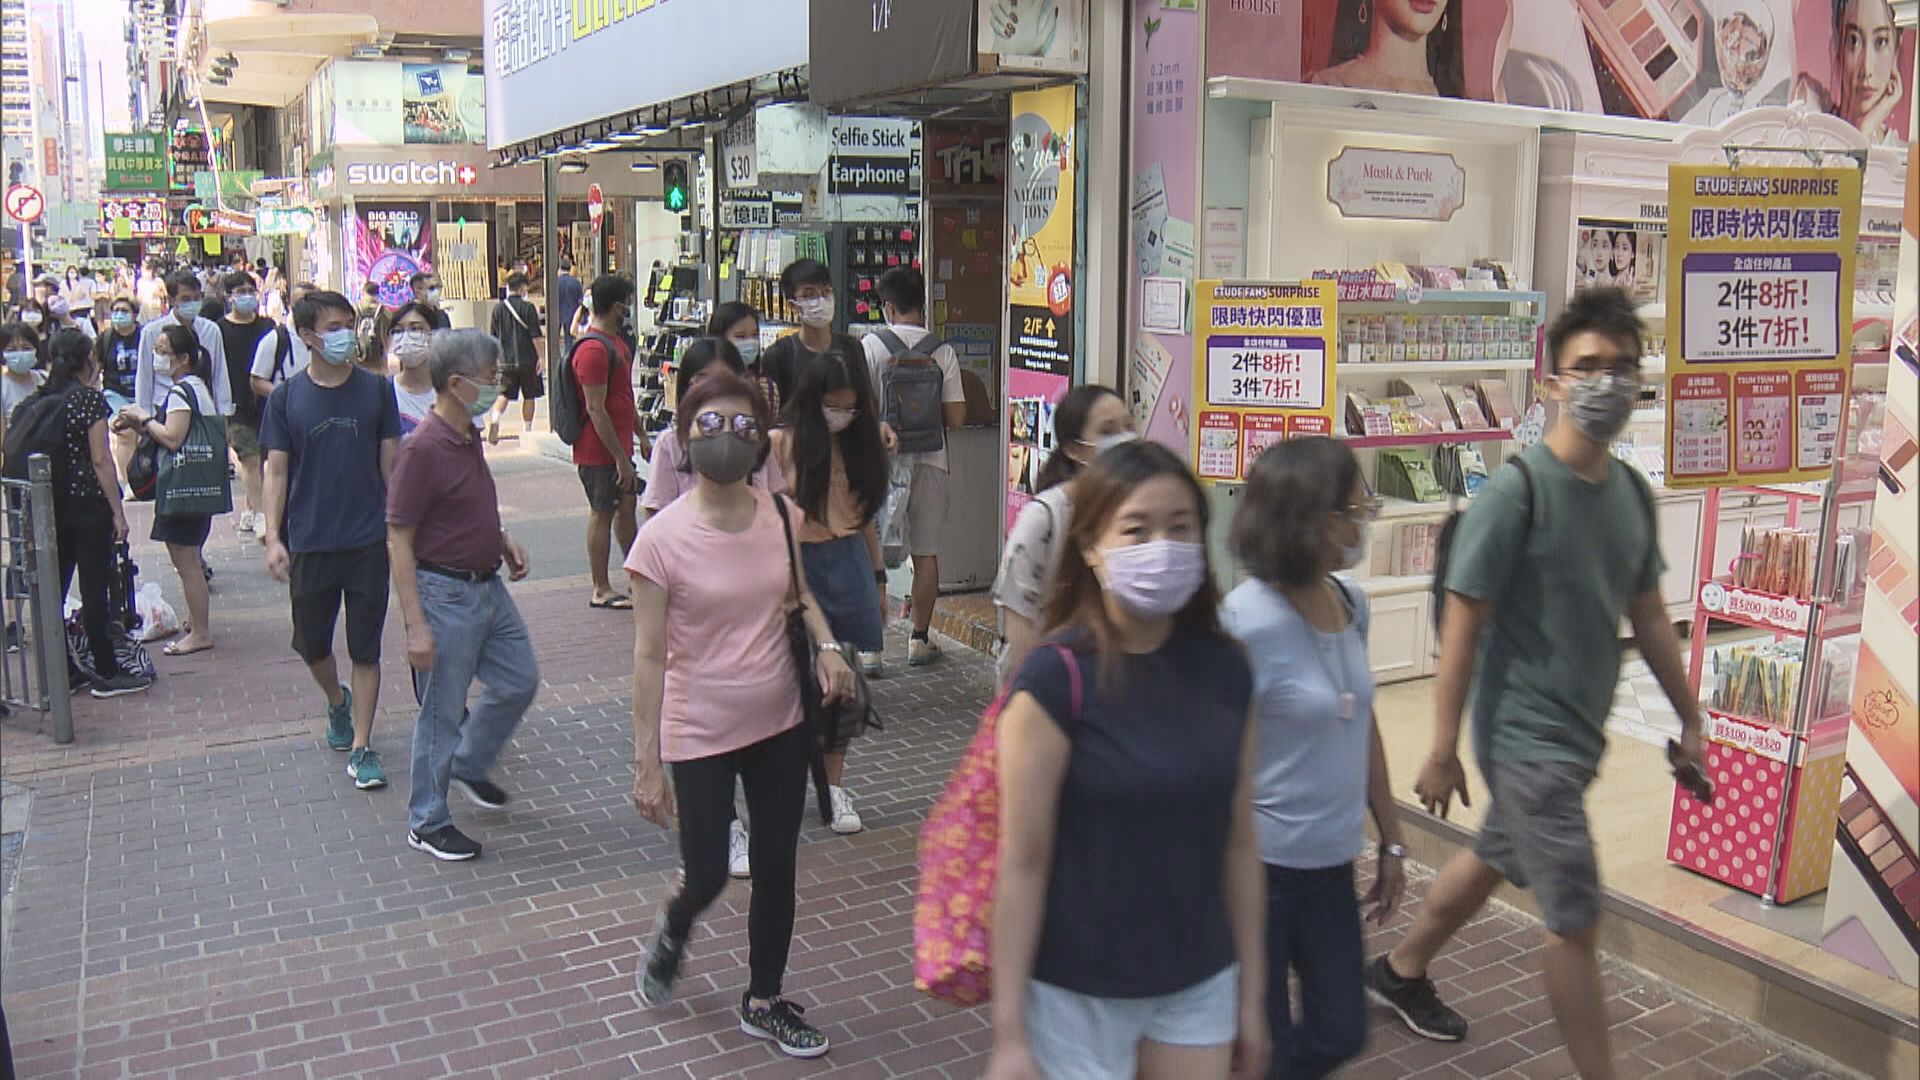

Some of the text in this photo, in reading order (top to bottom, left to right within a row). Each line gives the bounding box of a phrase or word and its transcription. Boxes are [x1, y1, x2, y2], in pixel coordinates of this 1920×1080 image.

[1150, 63, 1180, 77] 0.2mm
[832, 127, 905, 148] Selfie Stick
[347, 160, 458, 185] swatch
[731, 155, 750, 182] $30
[832, 163, 906, 188] Earphone
[1362, 163, 1433, 182] Mask & Pack
[1013, 186, 1059, 203] NAUGHTY
[1695, 176, 1839, 196] ETUDE FANS SURPRISE
[368, 211, 418, 221] BIG BOLD
[1023, 204, 1049, 219] TOYS
[1691, 207, 1842, 239] 限時快閃優惠
[1244, 286, 1267, 299] FANS
[1269, 286, 1320, 298] SURPRISE
[1717, 278, 1809, 311] 2件8折!
[1023, 317, 1043, 336] 2/F
[1211, 306, 1323, 327] 限時快閃優惠
[1717, 316, 1810, 348] 3件7折!
[1232, 352, 1301, 374] 2件8折!
[1232, 377, 1301, 399] 3件7折!
